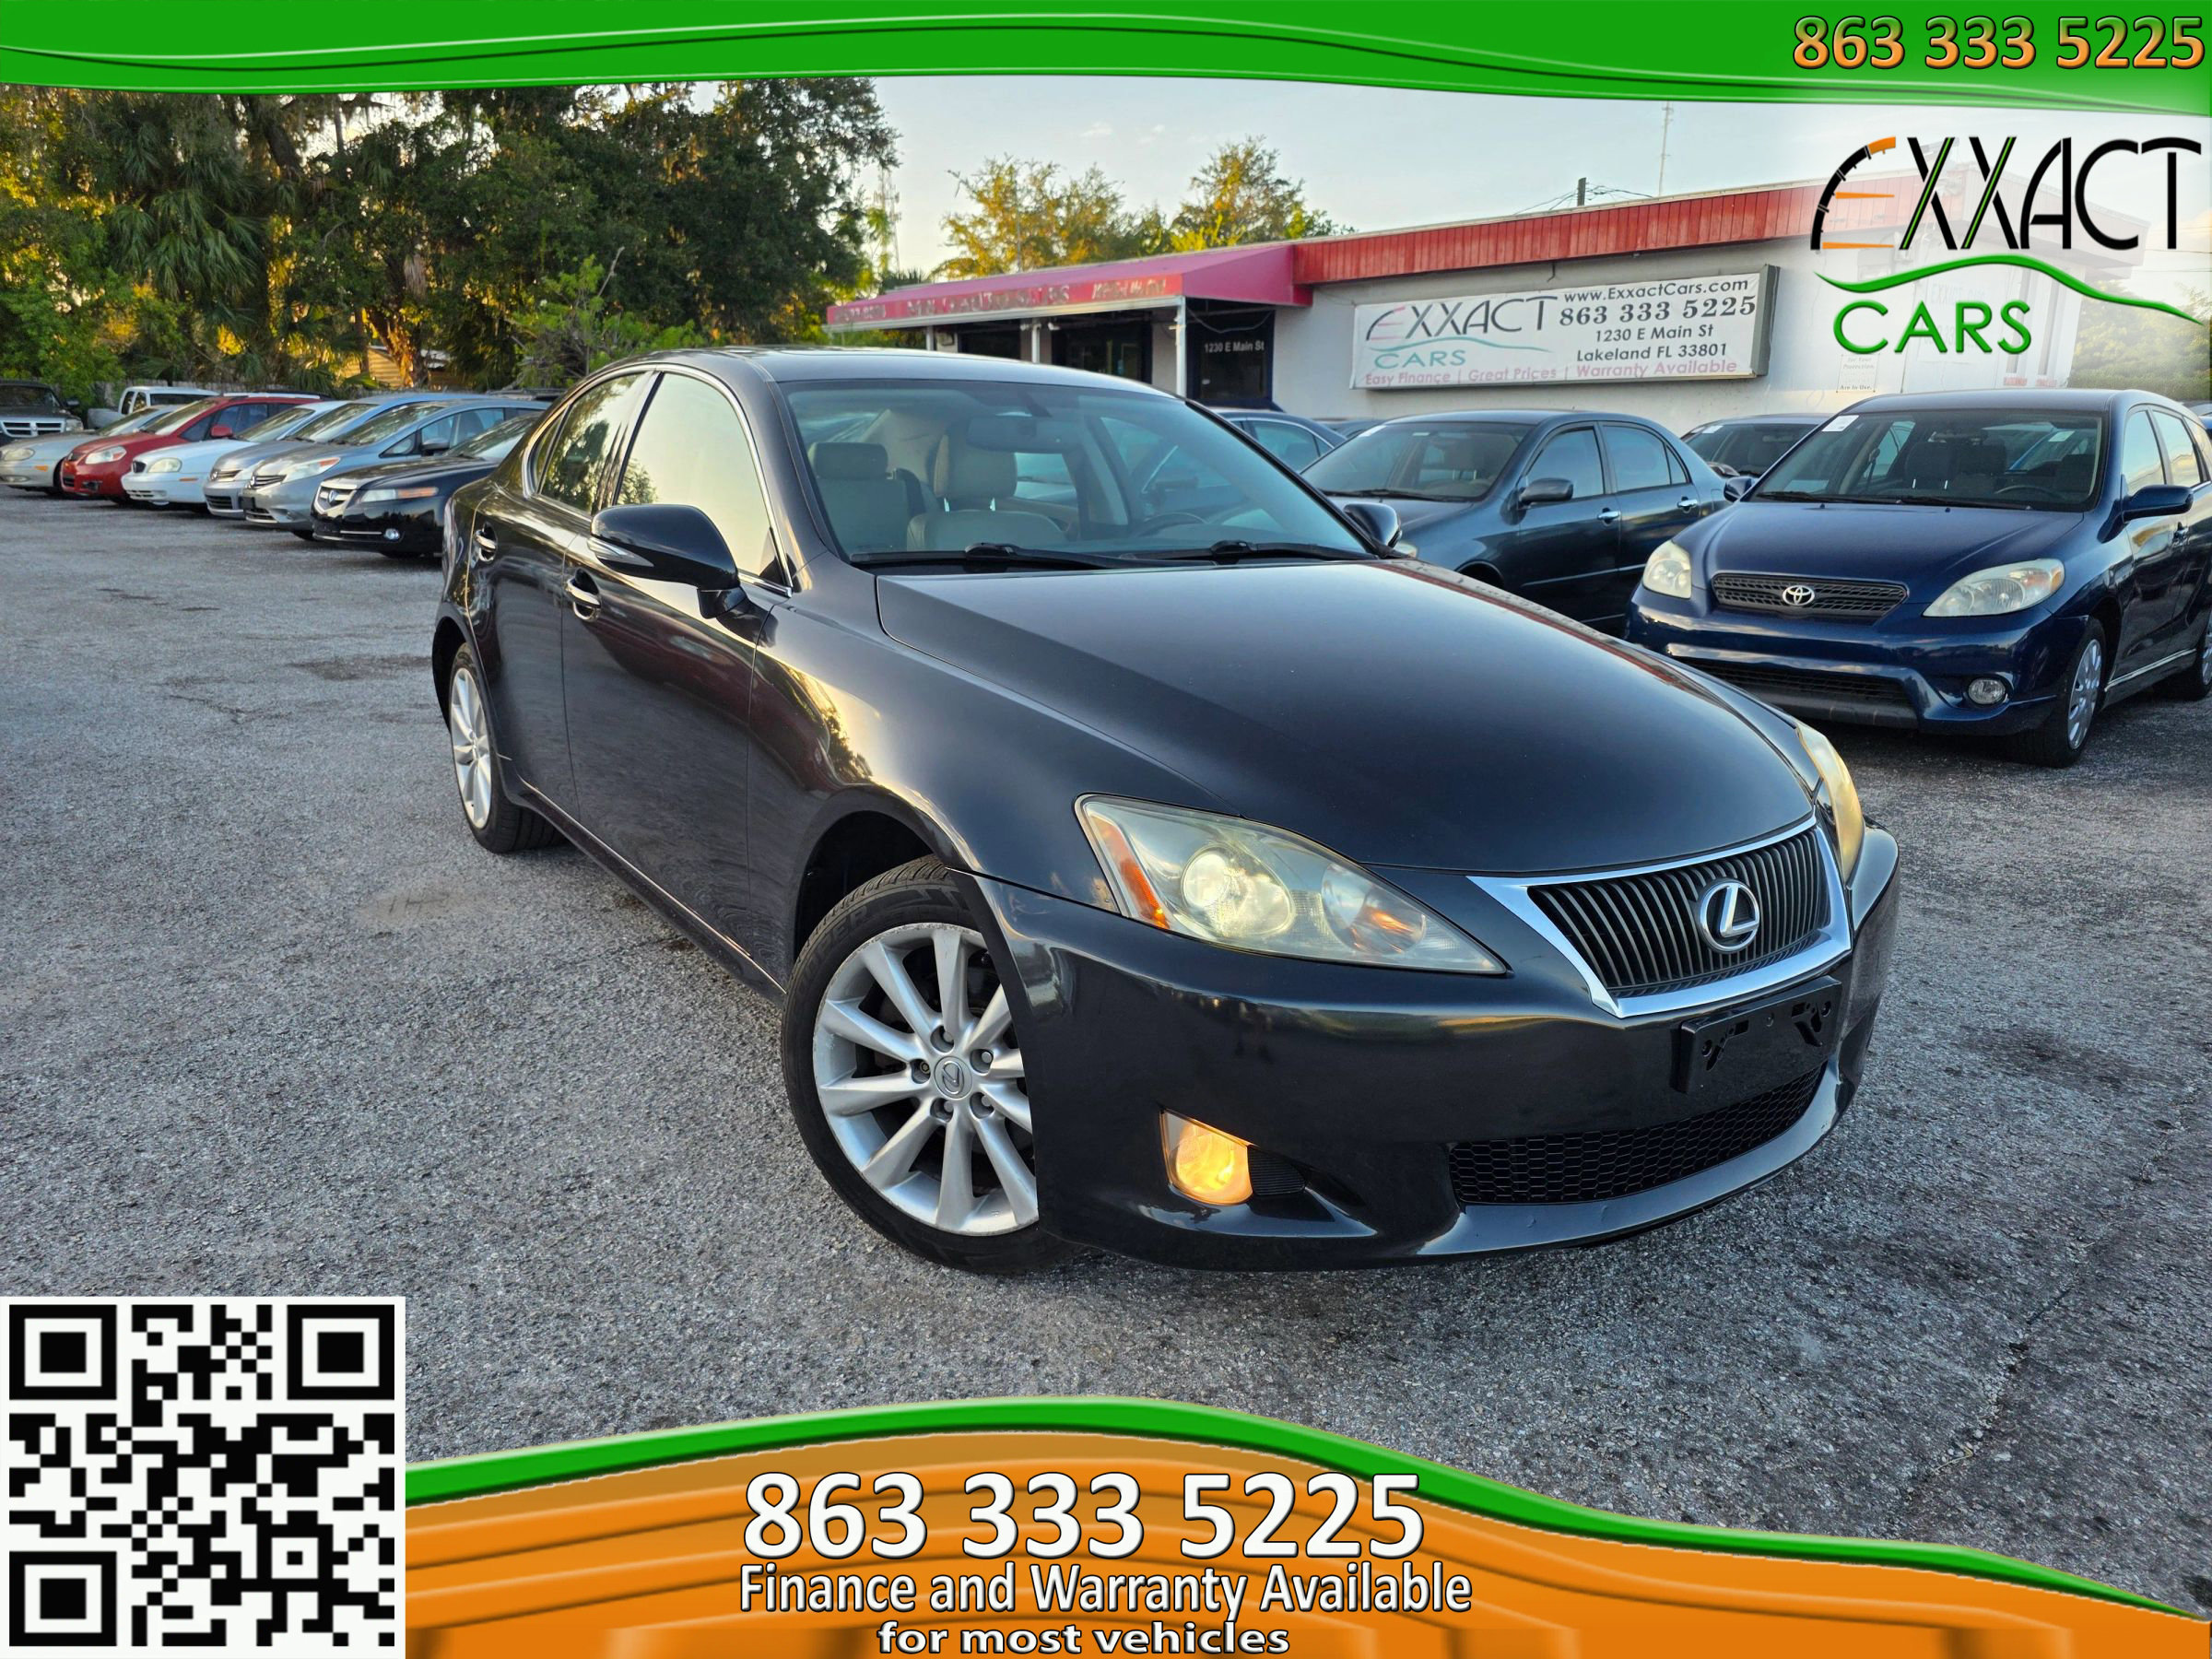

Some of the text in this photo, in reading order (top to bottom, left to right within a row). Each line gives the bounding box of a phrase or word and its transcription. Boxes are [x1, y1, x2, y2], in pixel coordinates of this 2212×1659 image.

[1564, 280, 1748, 302] www.ExxactCars.com
[1366, 296, 1558, 341] EXXACT
[1559, 295, 1756, 325] 863 333 5225
[1595, 324, 1713, 343] 1230 E Main St
[1225, 342, 1231, 352] E
[1233, 341, 1253, 352] Main
[1255, 340, 1265, 350] St
[1577, 343, 1726, 361] Lakeland FL 33801
[1374, 350, 1465, 369] CARS
[1366, 360, 1737, 386] Easy Finance Great Prices Warranty Available
